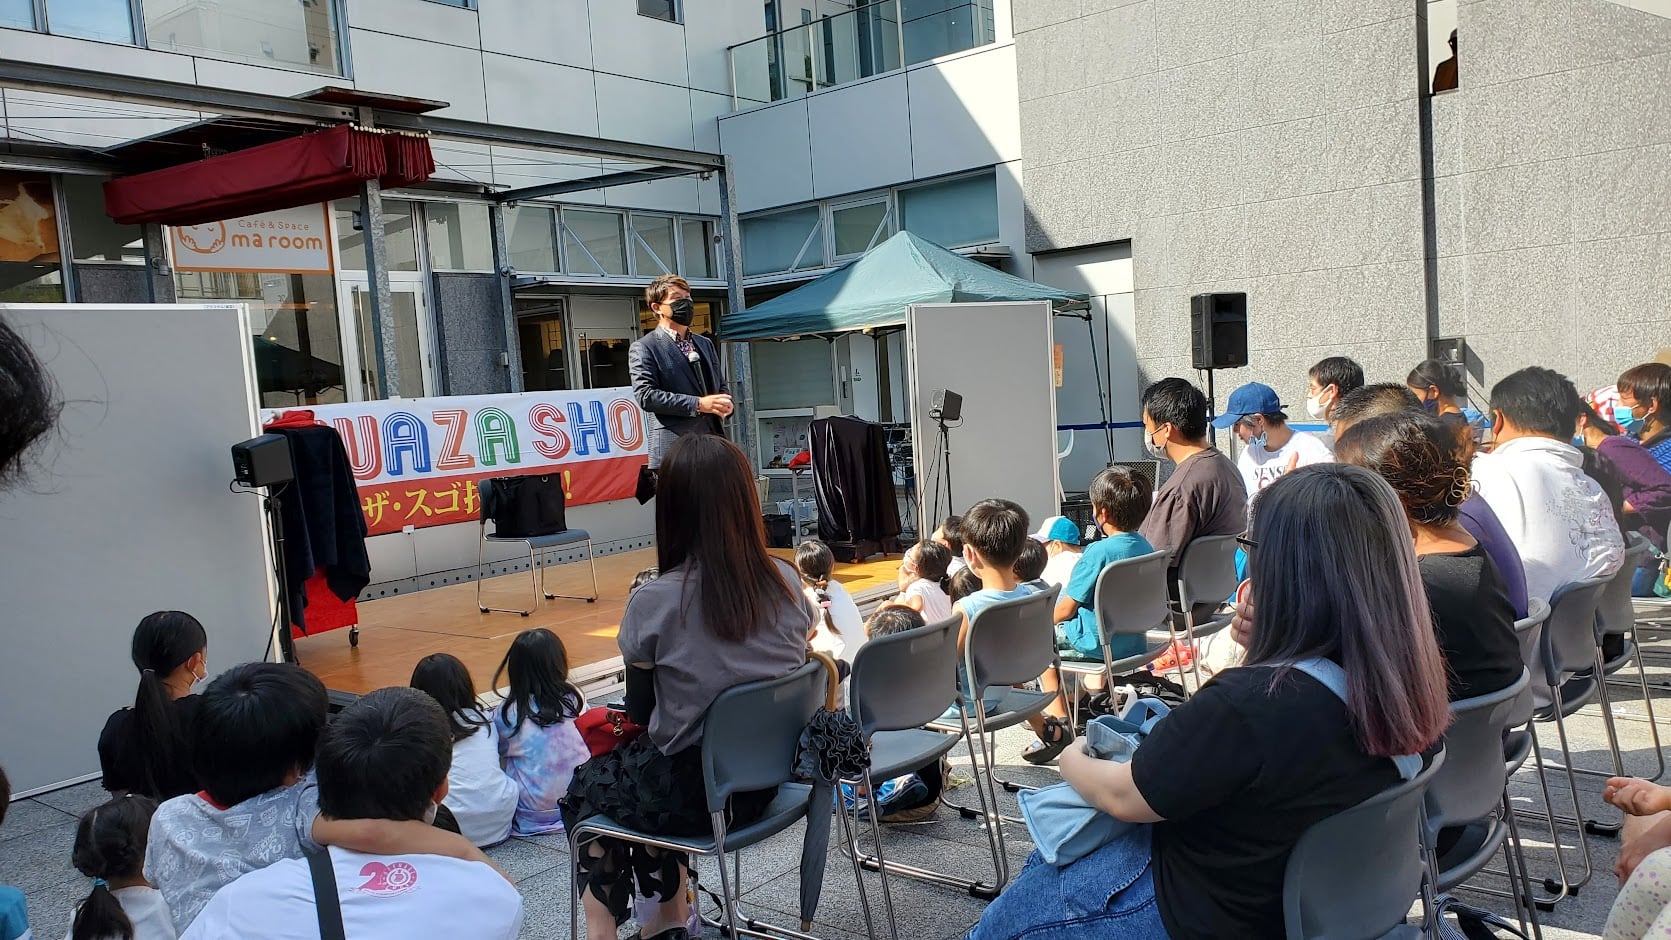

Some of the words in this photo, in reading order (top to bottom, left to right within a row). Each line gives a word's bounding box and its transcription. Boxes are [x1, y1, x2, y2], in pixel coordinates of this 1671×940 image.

[268, 220, 275, 230] &
[278, 221, 309, 232] Space
[231, 233, 263, 248] ma
[268, 235, 323, 250] room
[315, 406, 521, 481] UAZA
[528, 398, 648, 460] SHO
